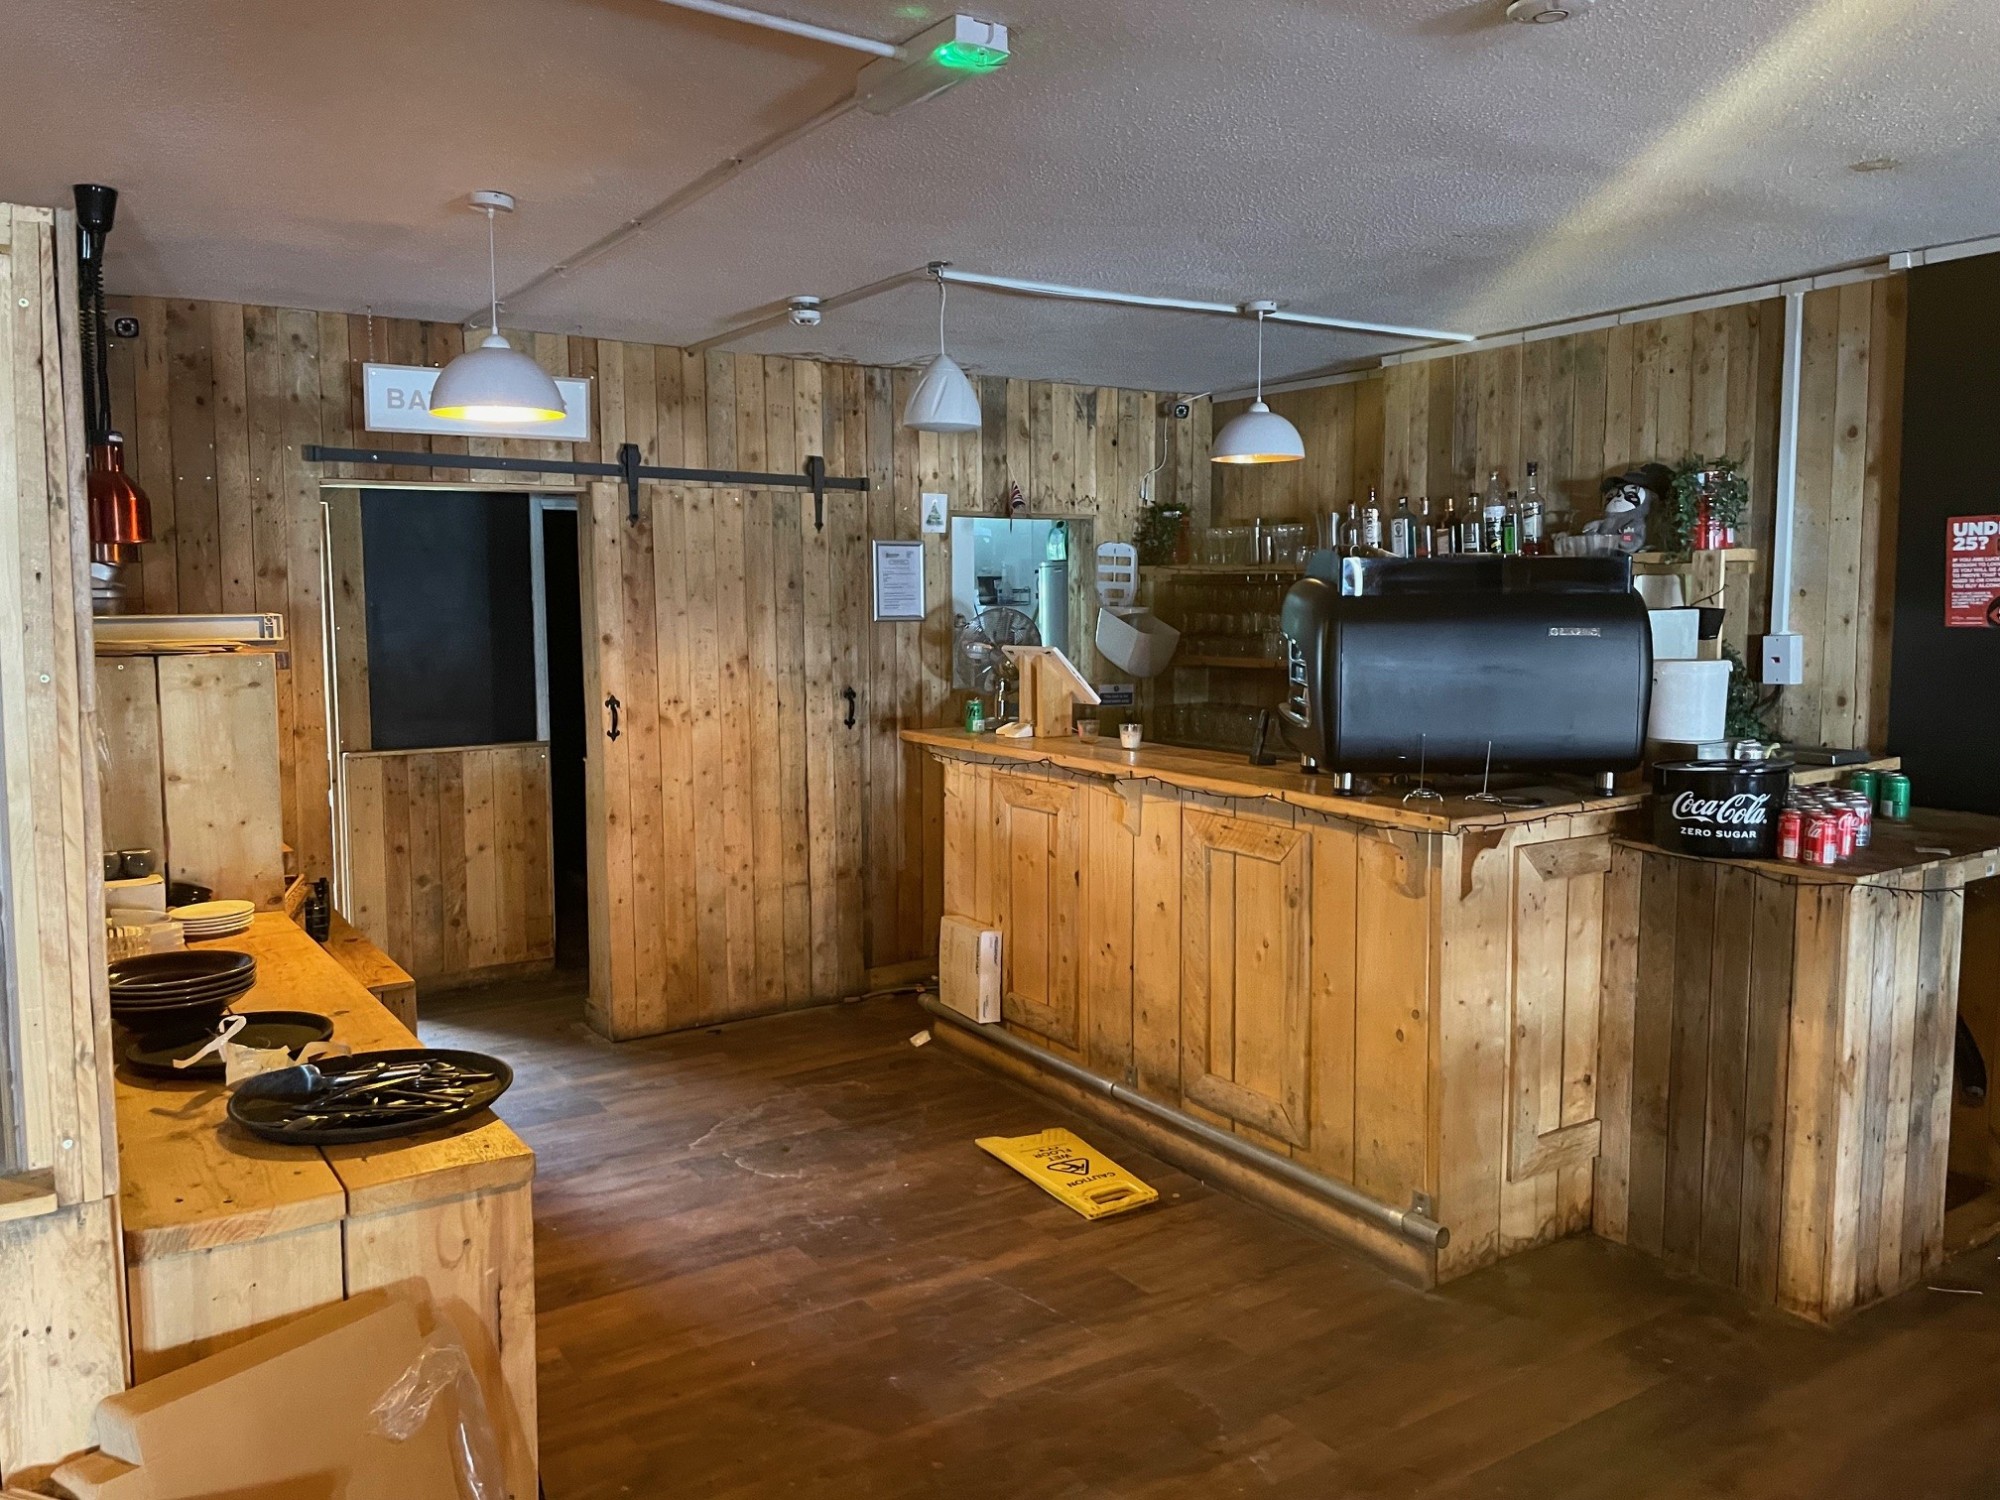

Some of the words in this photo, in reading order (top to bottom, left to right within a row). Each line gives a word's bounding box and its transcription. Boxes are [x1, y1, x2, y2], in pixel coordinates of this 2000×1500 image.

[1953, 521, 2000, 536] UND
[1952, 537, 1989, 551] 25?
[1680, 827, 1711, 837] ZERO
[1715, 830, 1757, 839] SUGAR
[1034, 1148, 1072, 1159] FLOOR
[1048, 1153, 1073, 1162] WET
[1066, 1171, 1116, 1188] CAUTION
